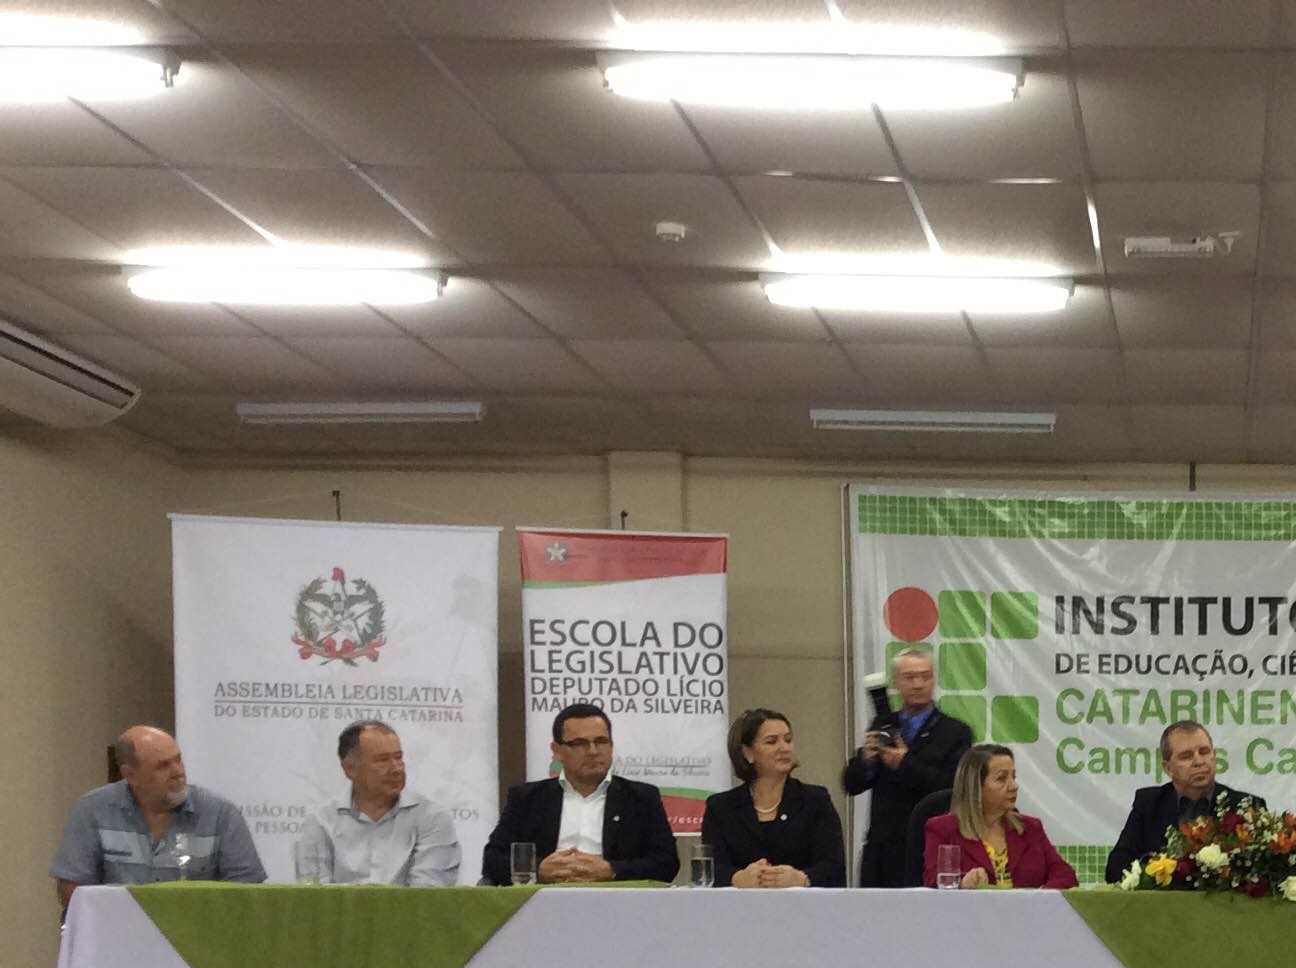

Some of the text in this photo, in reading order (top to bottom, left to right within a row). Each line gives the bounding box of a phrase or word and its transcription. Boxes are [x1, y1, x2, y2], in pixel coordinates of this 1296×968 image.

[529, 619, 724, 649] ESCOLA DO
[530, 649, 725, 676] LEGISLATIVO
[1055, 653, 1091, 675] DE
[1098, 650, 1254, 681] EDUCAÇÃO,
[214, 682, 464, 704] ASSEMBLEIA LEGISLATIVA
[531, 675, 725, 698] DEPUTADO LÍCIO
[214, 705, 464, 723] DO ESTADO DE SANTA CATARINA
[610, 698, 638, 713] DA
[643, 699, 725, 715] SILVEIRA
